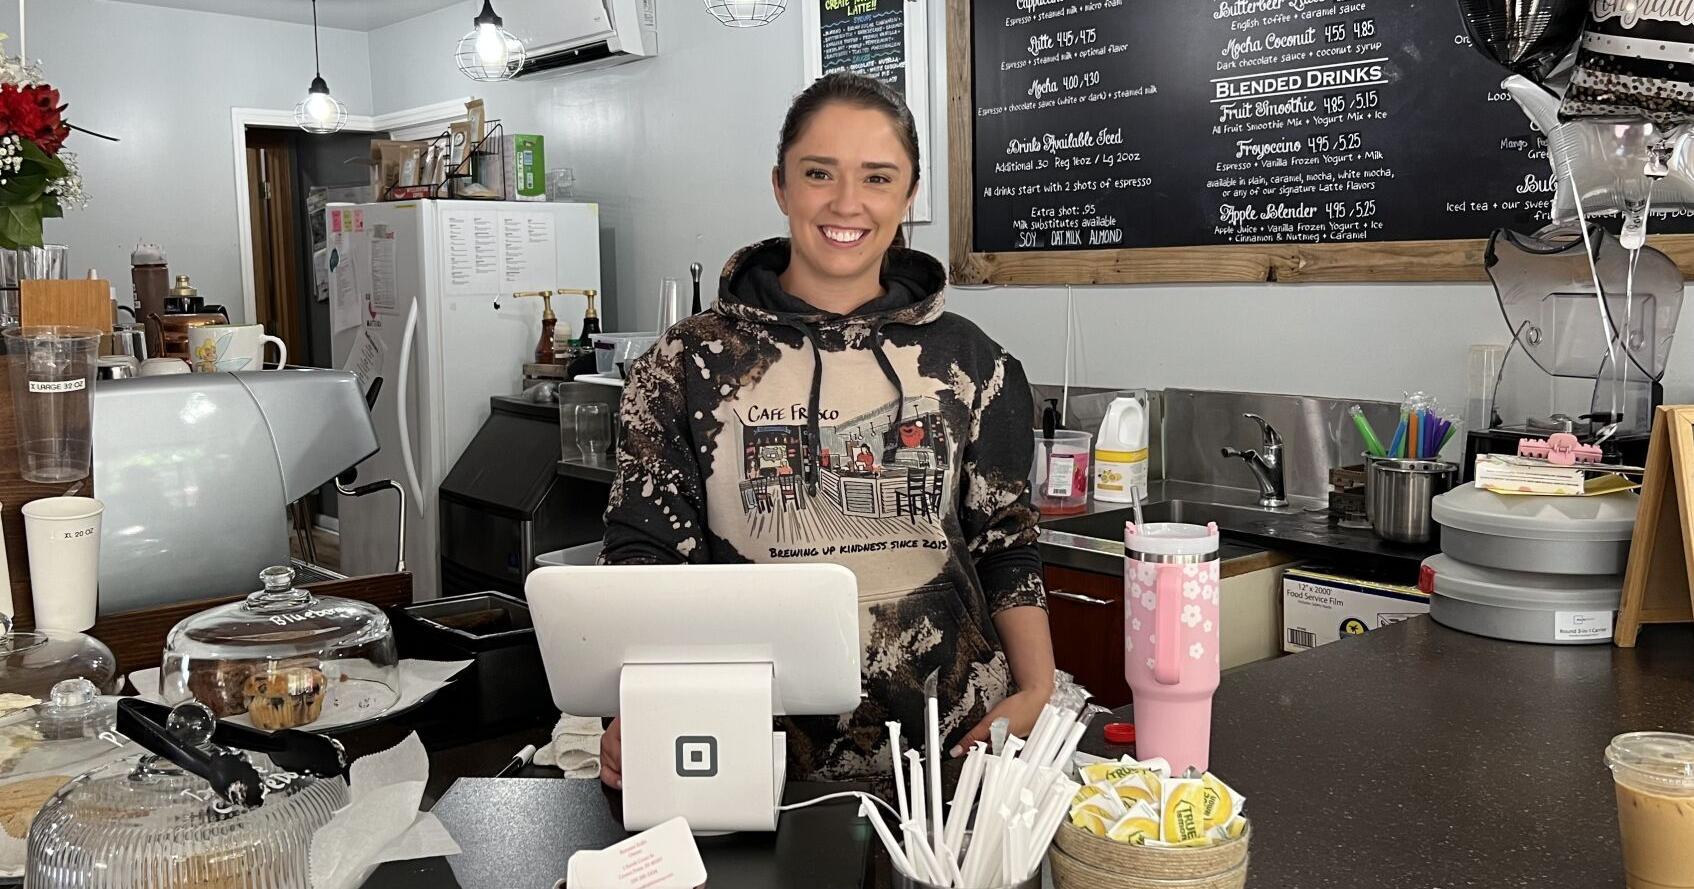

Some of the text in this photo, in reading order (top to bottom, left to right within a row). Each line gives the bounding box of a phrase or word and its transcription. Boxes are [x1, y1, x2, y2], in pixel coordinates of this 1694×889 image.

[1005, 17, 1032, 27] Espresso
[1038, 8, 1065, 21] steamed
[1066, 5, 1078, 15] milk
[1084, 2, 1102, 11] micro
[1231, 19, 1260, 32] English
[1263, 13, 1291, 26] toffee
[1301, 5, 1336, 20] caramel
[1338, 2, 1366, 15] sauce
[1028, 33, 1054, 56] Latte
[1221, 19, 1375, 59] Mocha Coconut 4.55 4.85
[1000, 60, 1027, 70] Espresso
[1033, 53, 1060, 66] steamed
[1061, 52, 1072, 61] milk
[1079, 46, 1106, 58] optional
[1216, 42, 1382, 71] Dark chocolate sauce coconut syrup
[1028, 77, 1058, 99] Mocha
[1216, 65, 1382, 99] BLENDED DRINKS
[977, 84, 1158, 116] Espresso chocolate sauce (white or dark) steamed milk
[1488, 91, 1512, 102] Loos
[1219, 101, 1253, 122] Fruit
[1255, 95, 1317, 117] Smoothie
[1323, 95, 1345, 114] 4.85
[1212, 125, 1221, 135] All
[1246, 120, 1284, 132] Smoothie
[1286, 117, 1303, 127] Mix
[1313, 114, 1343, 127] Yogurt
[1347, 112, 1364, 121] Mix
[1374, 110, 1388, 119] Ice
[1006, 127, 1123, 155] Drinks Available Iced
[1235, 136, 1301, 160] Froyoccino
[1307, 135, 1329, 153] 4.95
[1501, 137, 1528, 151] Mango
[994, 160, 1034, 173] Additional
[1054, 156, 1070, 170] Reg
[1102, 153, 1114, 167] Lg
[1116, 152, 1141, 163] 20oz
[1215, 150, 1384, 172] Espresso Vanilla Frozen Yogurt Milk
[983, 177, 1152, 198] All drinks start with 2 shots of espresso
[1206, 167, 1395, 188] available in plain, caramel, mocha, white mocha,
[1222, 189, 1231, 198] or
[1233, 188, 1247, 198] any
[1249, 186, 1260, 196] of
[1262, 187, 1276, 195] our
[1278, 183, 1316, 196] signature
[1319, 182, 1344, 192] Latte
[1031, 204, 1096, 218] Extra shot: .95
[1219, 203, 1258, 226] Apple
[1260, 202, 1317, 220] Blender
[1325, 201, 1346, 219] 4.95
[1446, 201, 1466, 212] Iced
[1470, 202, 1488, 211] tea
[1501, 201, 1520, 210] our
[1013, 214, 1117, 230] Milk substitutes available
[1214, 220, 1384, 235] Apple Juice Vanilla Frozen Yogurt Ice
[1019, 228, 1123, 248] SOY OAT MILK ALMOND
[1235, 231, 1367, 243] Cinnamon & Nutmeg Caramel
[38, 383, 62, 391] LARGE
[747, 404, 786, 423] CAFE
[64, 527, 95, 539] XL 20 OZ
[769, 539, 948, 558] BREWING UP KINDNESS SINCE 2013
[1287, 589, 1304, 599] Food
[1304, 592, 1329, 604] Service
[1329, 597, 1344, 607] Film
[1177, 806, 1197, 840] TRUE
